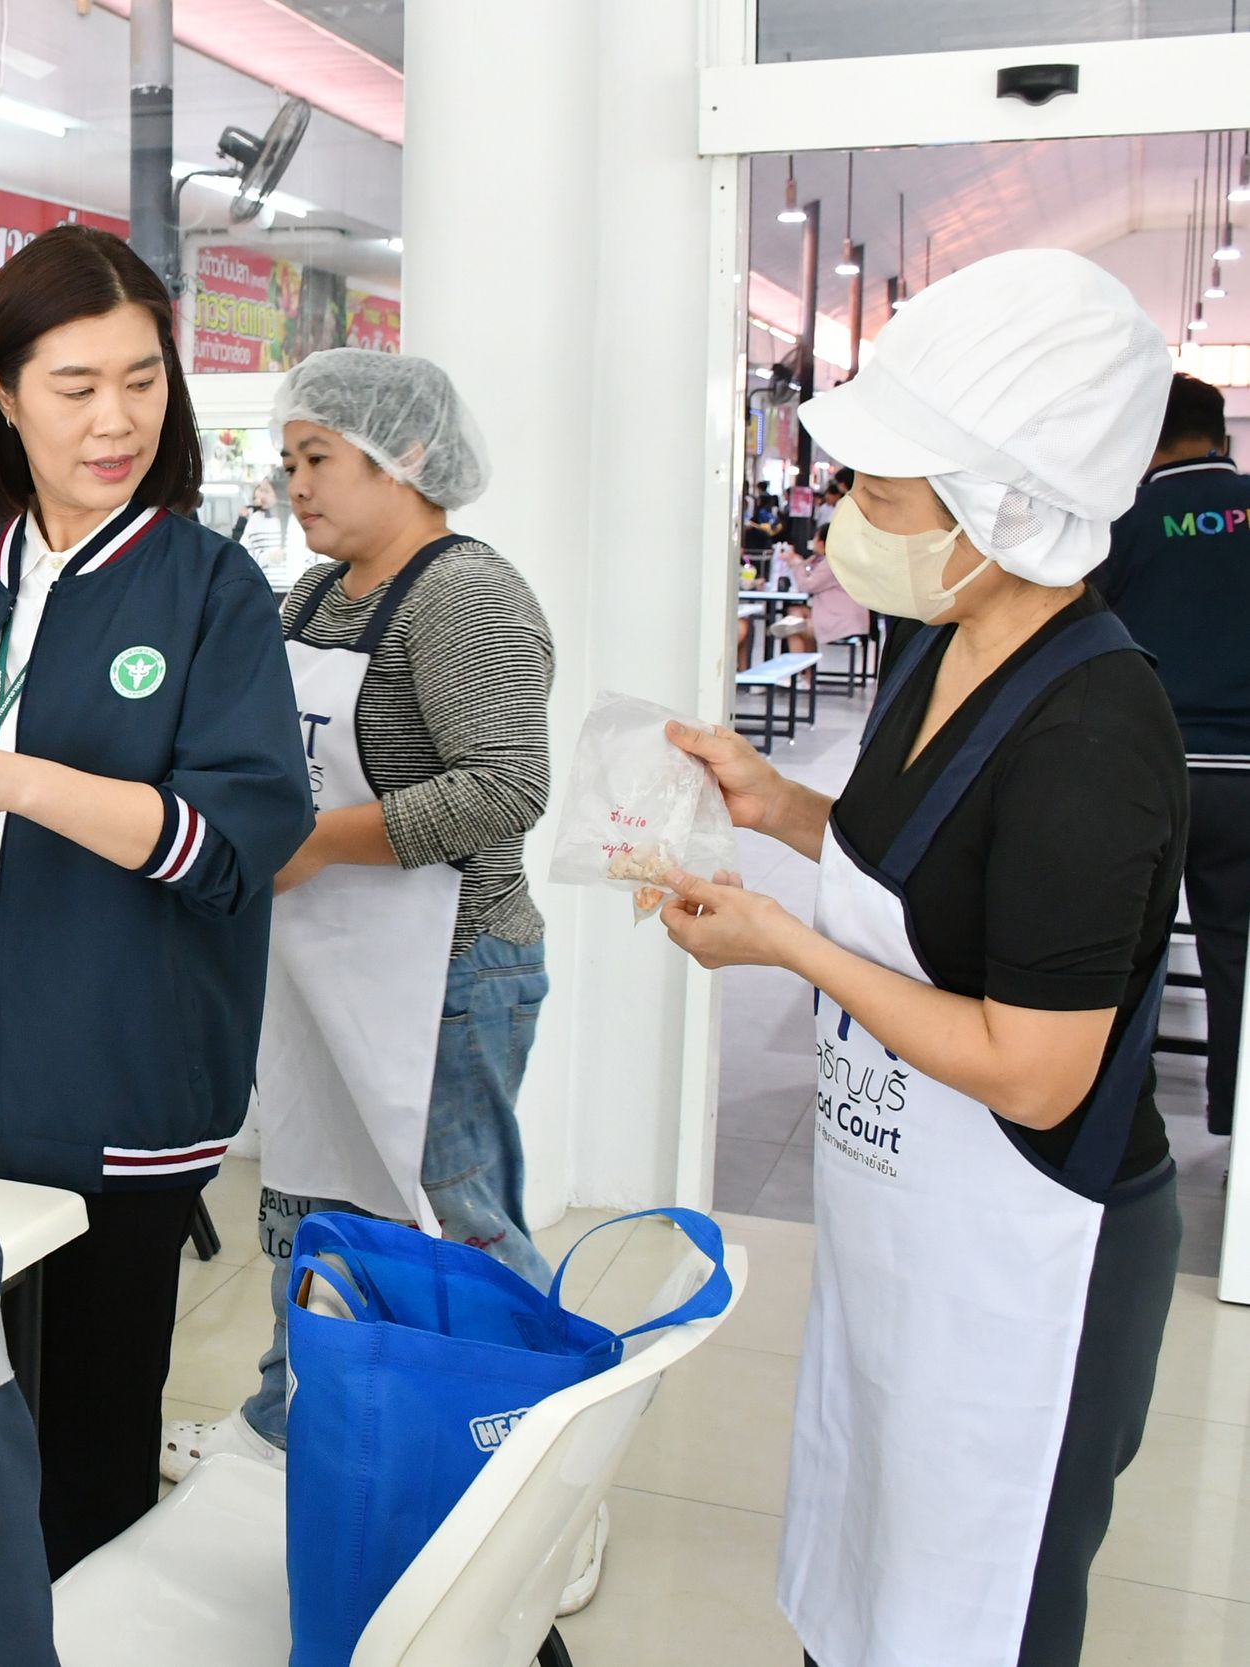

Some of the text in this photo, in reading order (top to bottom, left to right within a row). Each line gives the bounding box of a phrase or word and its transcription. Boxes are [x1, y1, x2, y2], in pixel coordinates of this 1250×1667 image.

[1163, 508, 1250, 538] MOP
[837, 1102, 901, 1154] Court
[470, 1407, 529, 1452] HE
